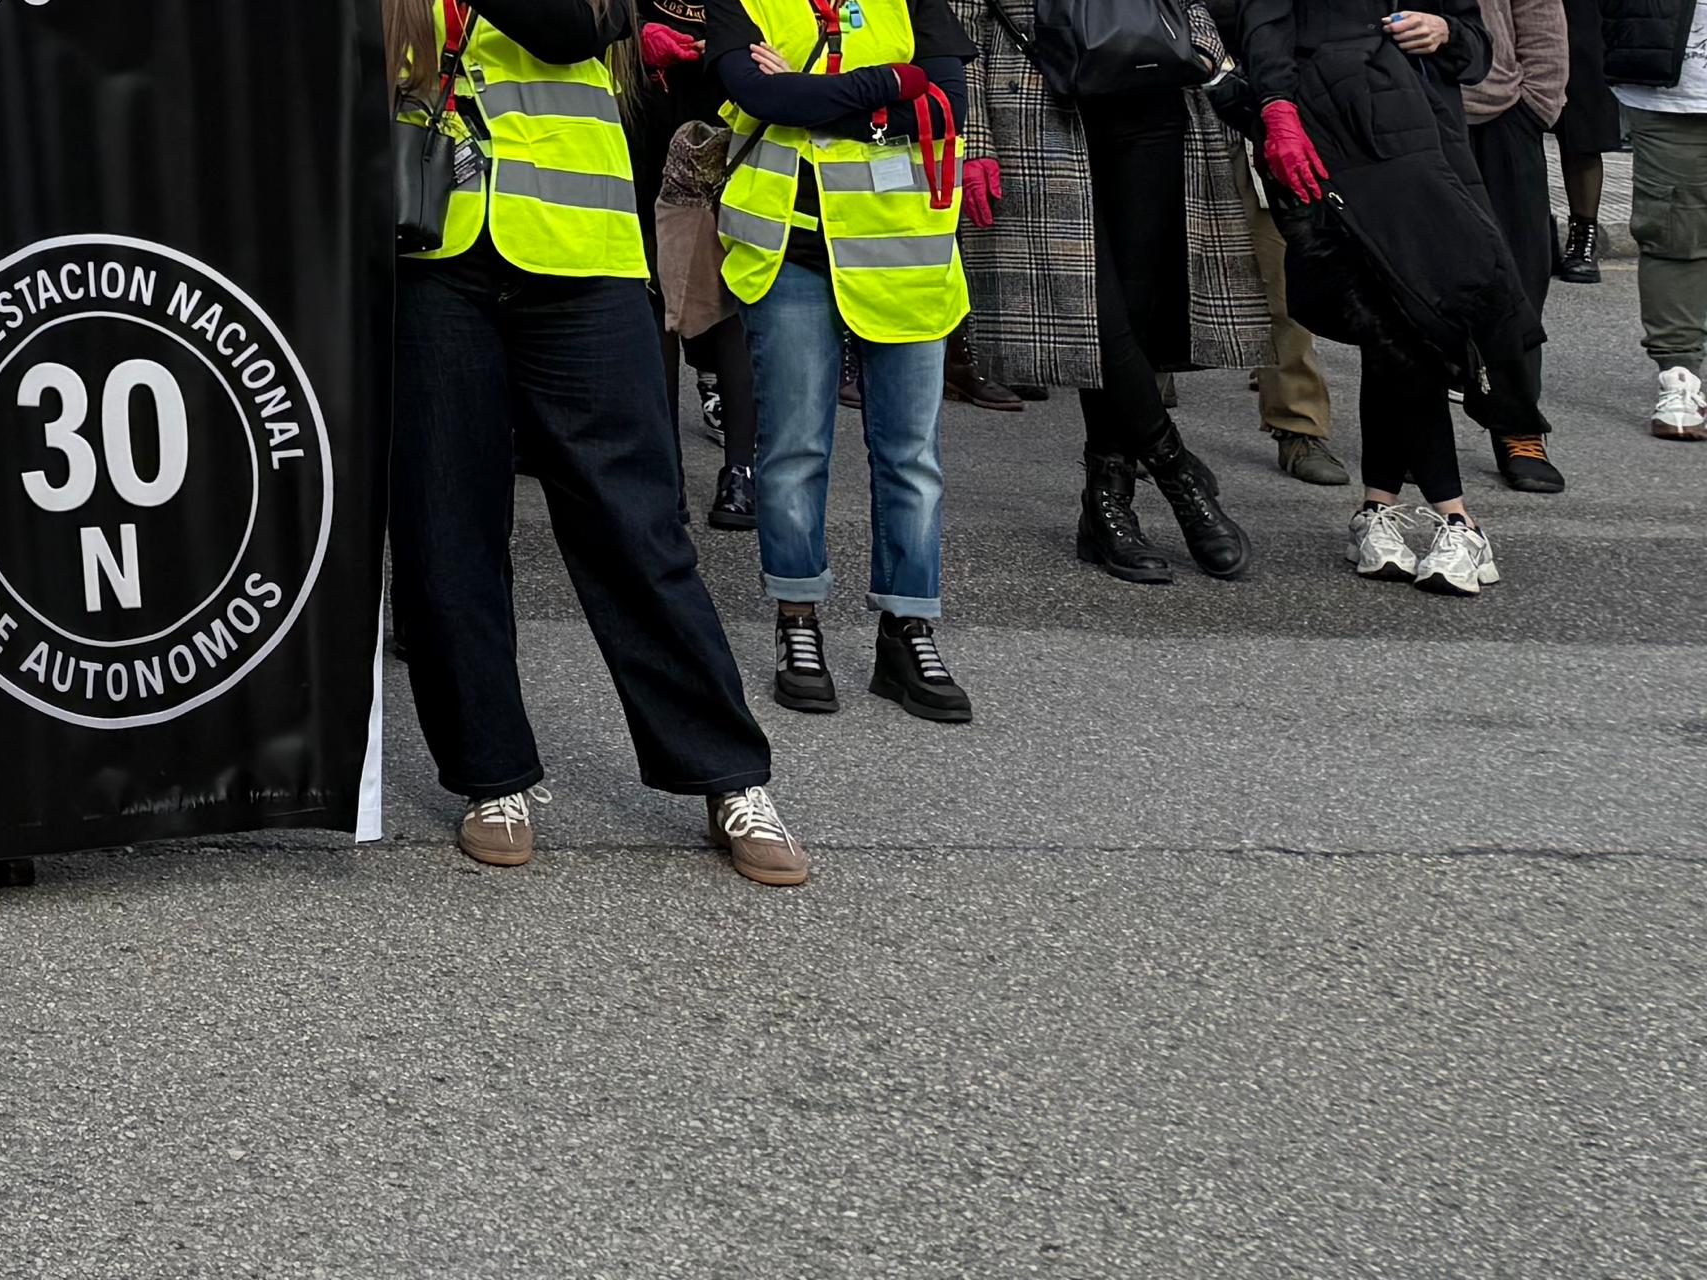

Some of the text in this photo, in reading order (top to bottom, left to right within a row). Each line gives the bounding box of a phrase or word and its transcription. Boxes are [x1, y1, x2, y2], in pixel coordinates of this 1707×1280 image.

[17, 358, 188, 512] 30
[167, 281, 305, 470] NACIONAL
[19, 572, 283, 702] AUTONOMOS
[80, 523, 142, 612] N
